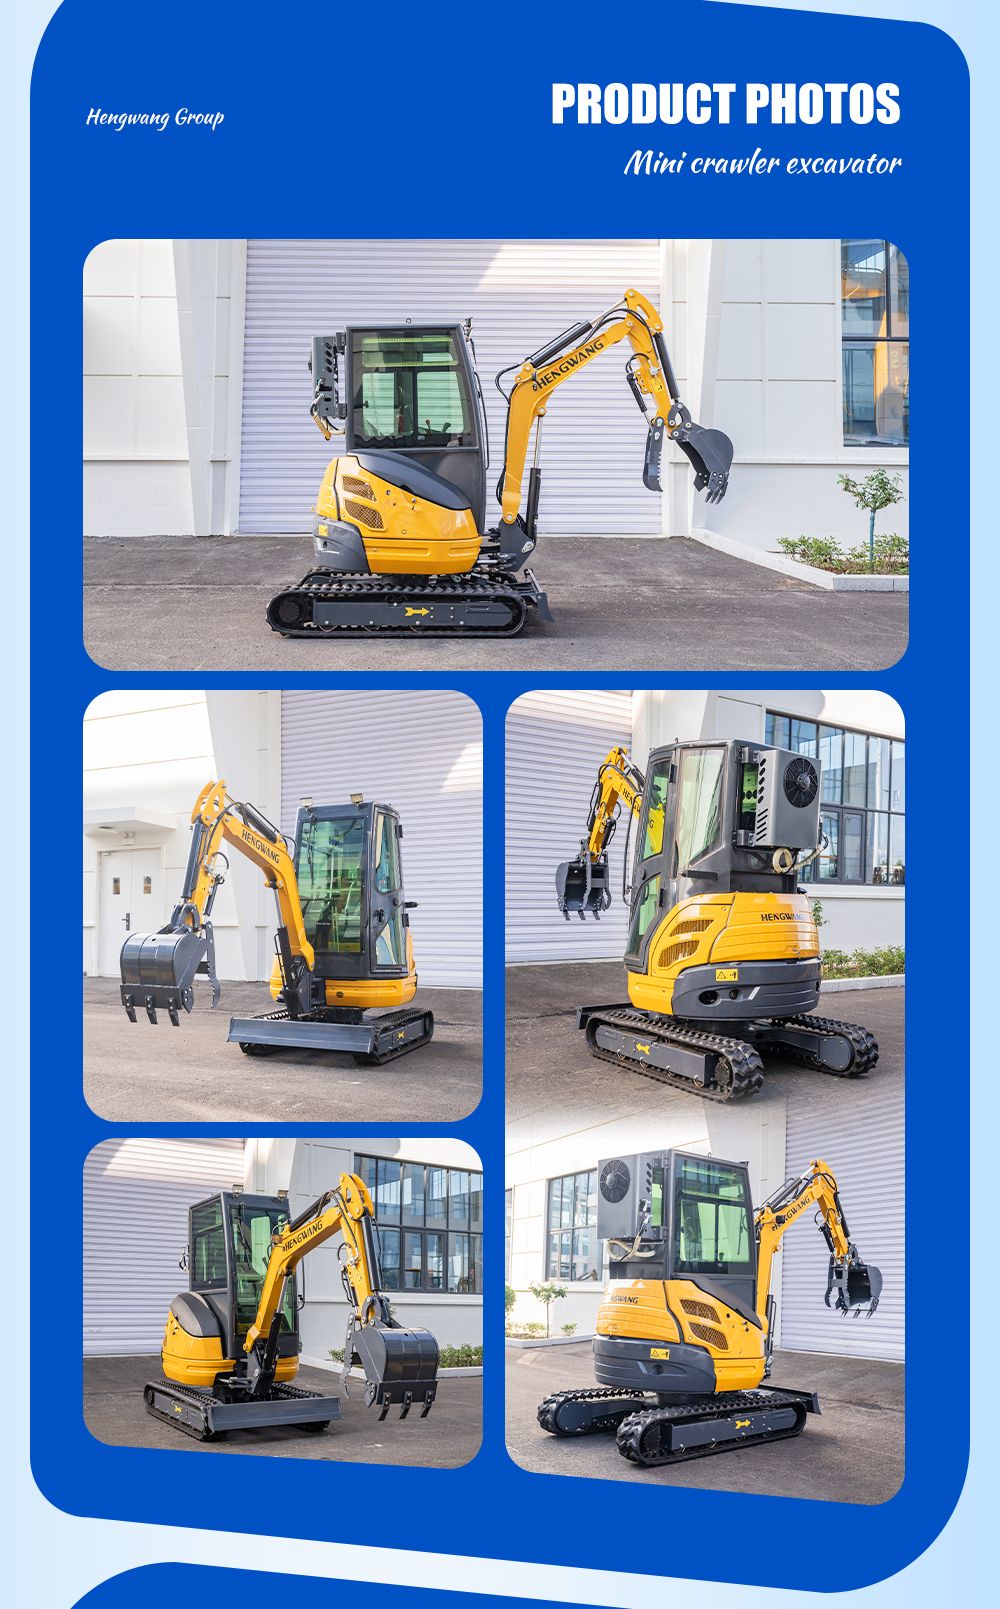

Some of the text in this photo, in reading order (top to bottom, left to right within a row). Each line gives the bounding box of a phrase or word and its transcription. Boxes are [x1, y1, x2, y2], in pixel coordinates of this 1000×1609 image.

[536, 339, 604, 389] HENGWANG
[241, 829, 280, 863] HENGWANG
[284, 1220, 323, 1252] HENGWANG
